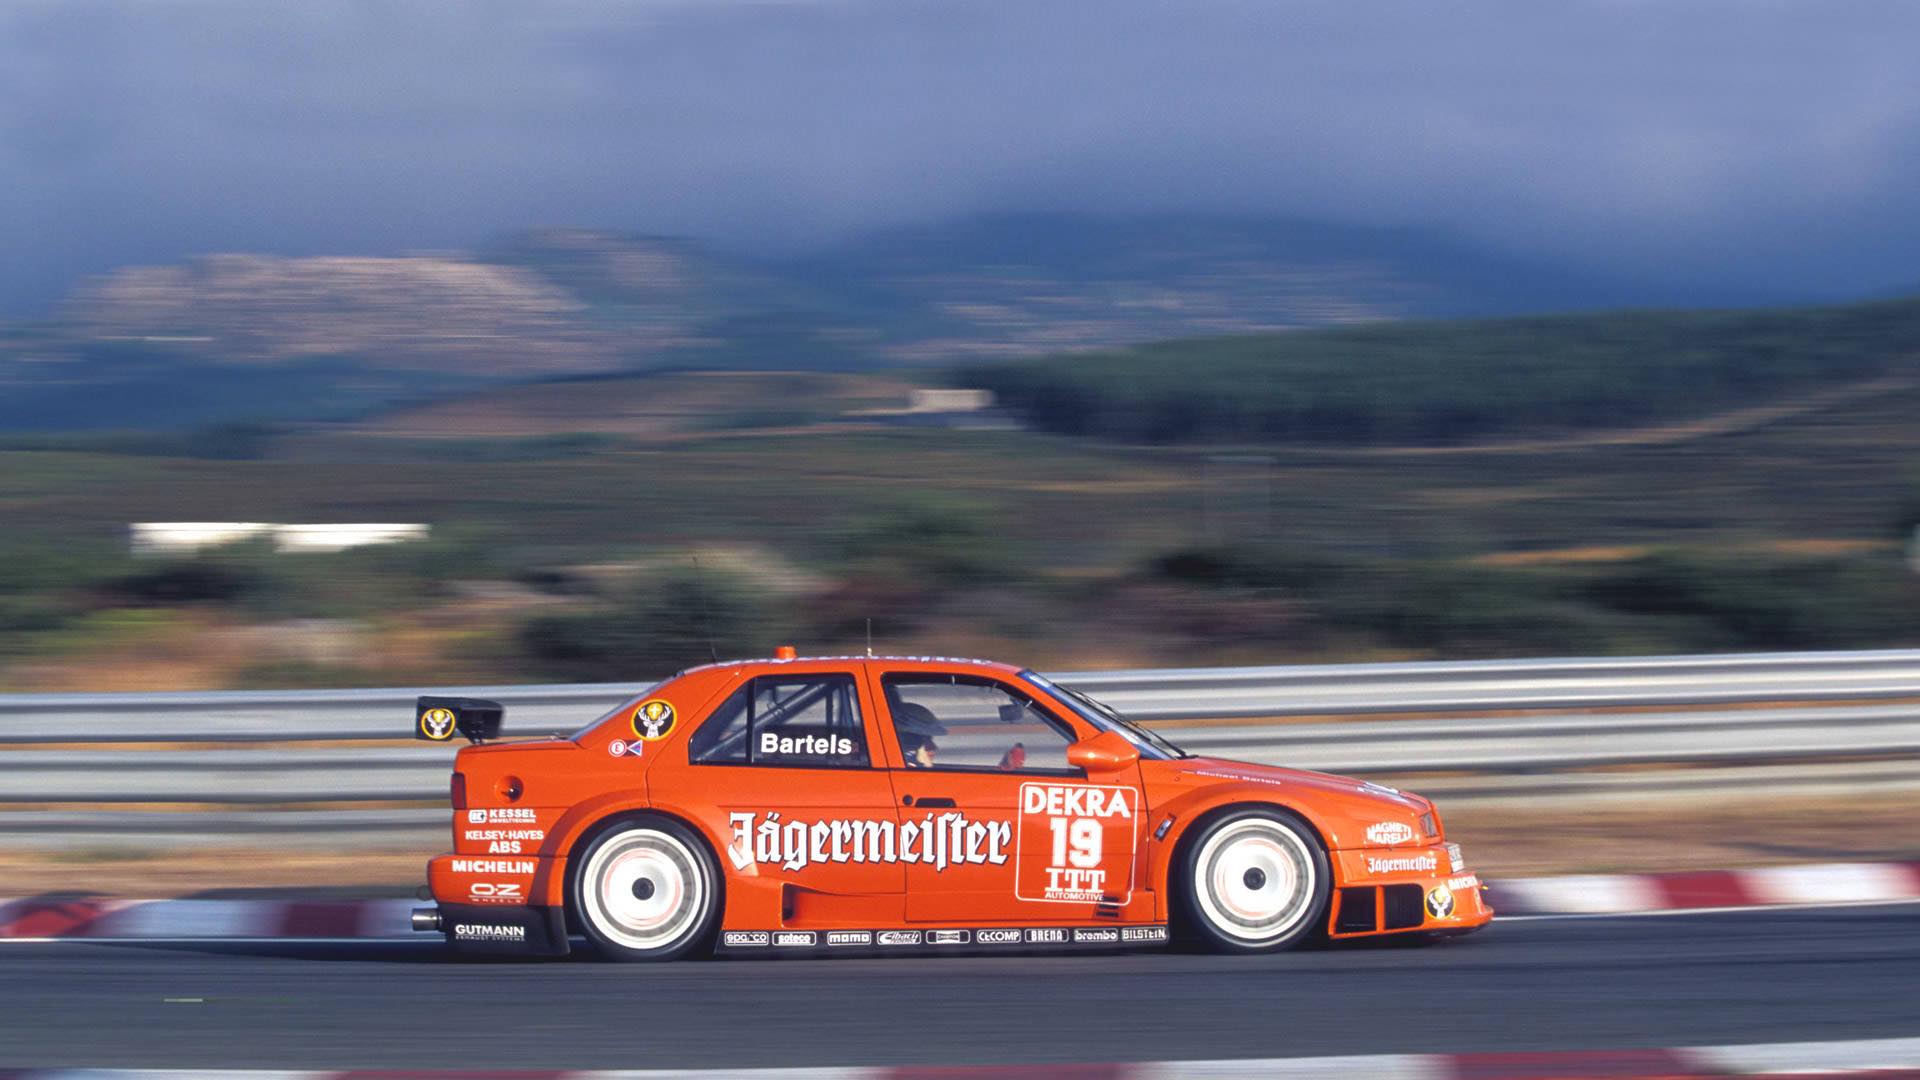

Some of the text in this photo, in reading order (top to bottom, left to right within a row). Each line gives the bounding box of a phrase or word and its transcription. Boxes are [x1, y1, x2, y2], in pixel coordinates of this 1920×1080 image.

[761, 732, 853, 755] Bartels
[1024, 786, 1132, 818] DEKRA
[489, 808, 537, 818] KESSEL
[465, 830, 544, 840] KELSEY-HAYES
[488, 841, 522, 854] ABS
[1050, 817, 1103, 868] 19
[452, 860, 534, 873] MICHELIN
[1045, 868, 1105, 893] ITT
[1044, 892, 1104, 901] AUTOMOTIVE
[455, 924, 525, 936] GUTMANN
[1075, 929, 1117, 940] brembo
[1122, 929, 1166, 940] BILSTEIN
[830, 934, 870, 943] momo
